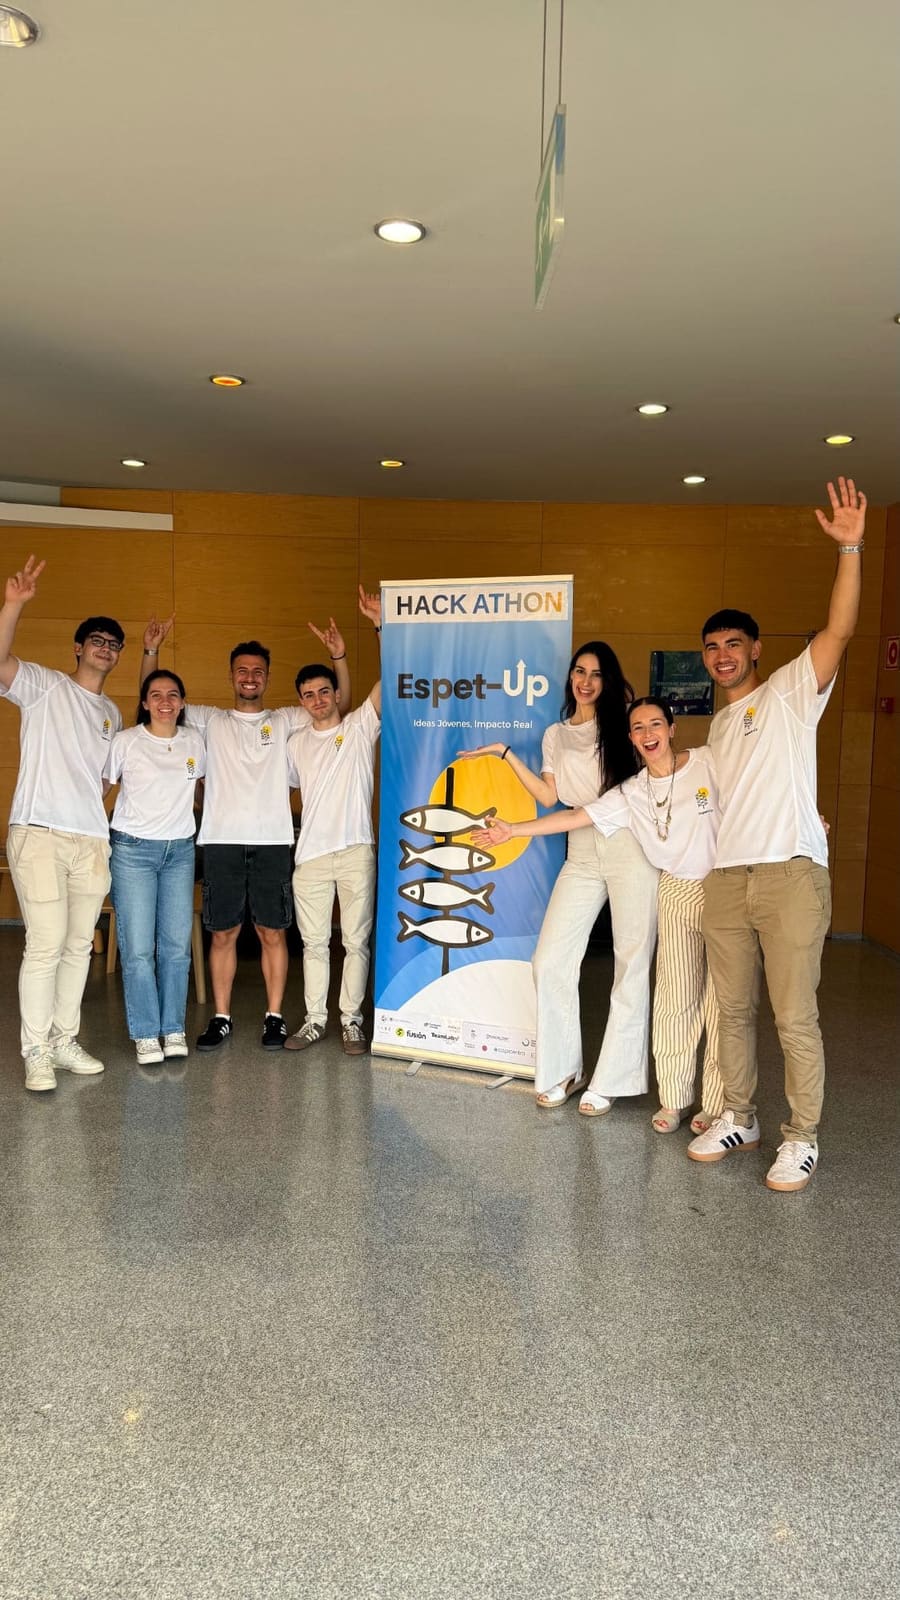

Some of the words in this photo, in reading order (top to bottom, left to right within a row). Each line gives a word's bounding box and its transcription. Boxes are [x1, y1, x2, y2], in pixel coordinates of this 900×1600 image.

[398, 658, 549, 709] Espet-Up
[413, 719, 436, 728] Ideas
[437, 719, 473, 729] Jóvenes,
[474, 719, 511, 730] Impacto
[513, 719, 533, 729] Real
